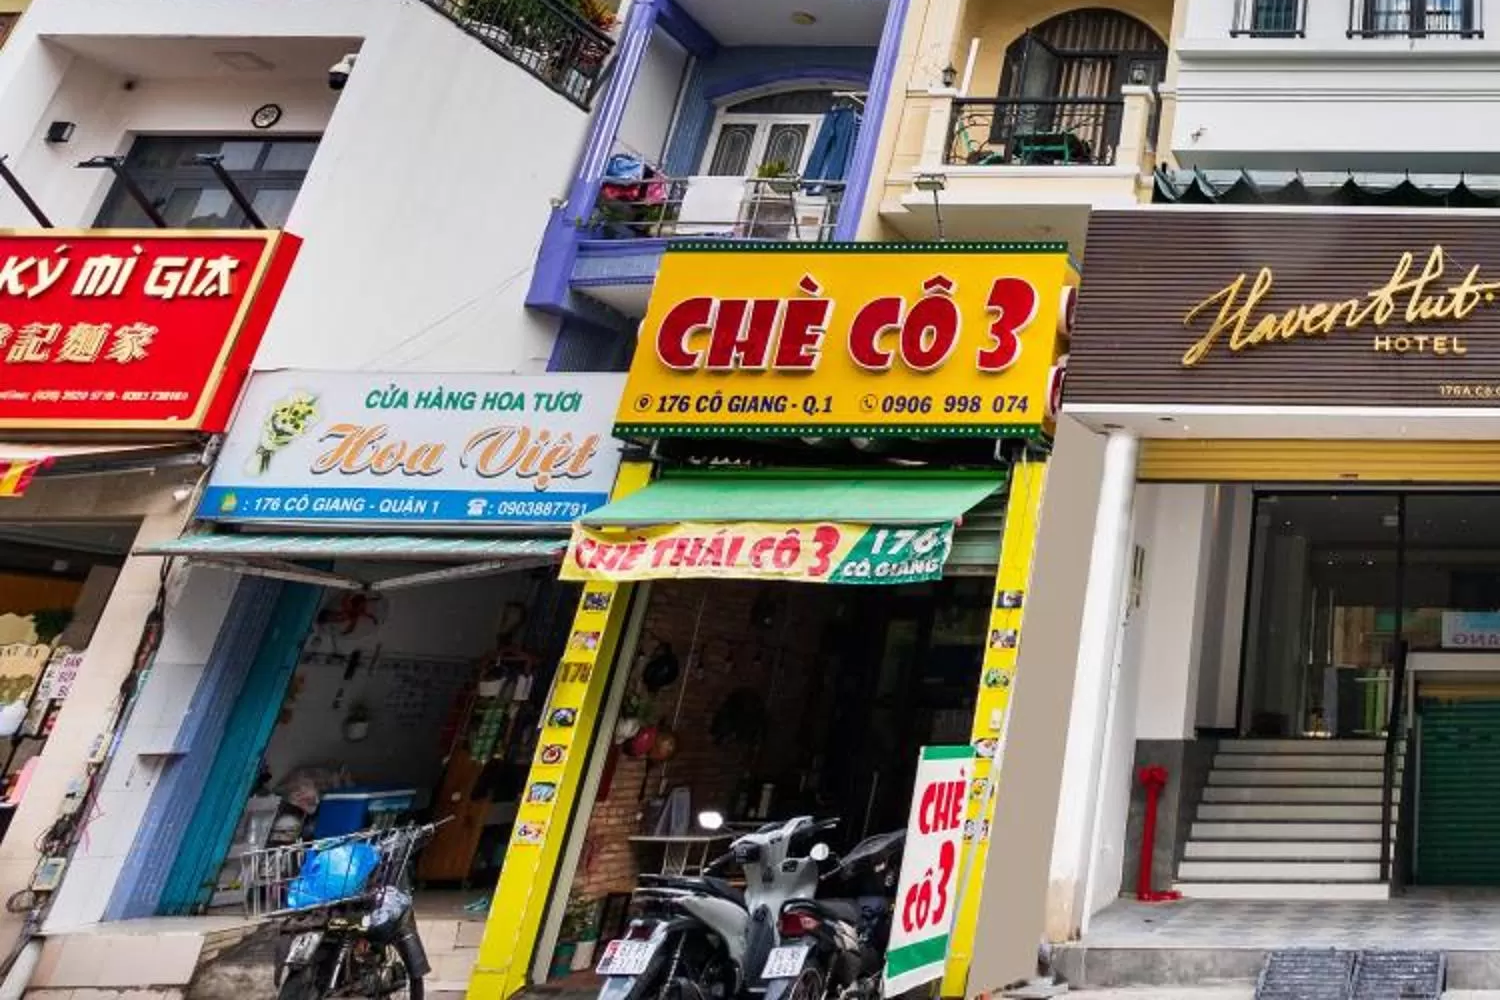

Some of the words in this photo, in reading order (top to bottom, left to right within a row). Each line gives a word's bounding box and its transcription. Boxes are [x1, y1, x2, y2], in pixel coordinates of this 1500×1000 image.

[144, 254, 240, 299] GIA
[657, 273, 835, 373] CHÈ
[848, 274, 961, 373] CÔ
[976, 276, 1039, 374] 3
[1374, 335, 1468, 353] HOTEL
[365, 384, 408, 410] CỬA
[413, 385, 480, 411] HÀNG
[483, 391, 526, 412] HOA
[533, 391, 583, 413] TƯƠI
[656, 394, 690, 413] 176
[695, 389, 724, 413] CÔ
[727, 394, 788, 413] GIANG
[882, 395, 932, 413] 0906
[944, 395, 981, 413] 998
[992, 395, 1029, 413] 074
[310, 423, 444, 478] Hoa
[459, 424, 601, 492] Việt
[254, 497, 281, 512] 176
[284, 495, 311, 512] CÔ
[313, 497, 366, 513] GIANG
[751, 528, 801, 570] CÔ
[808, 525, 841, 577] 3
[871, 528, 942, 558] 176
[875, 559, 940, 578] GIANG
[918, 767, 967, 835] CHÈ
[902, 867, 933, 933] CÔ
[931, 839, 955, 925] 3
